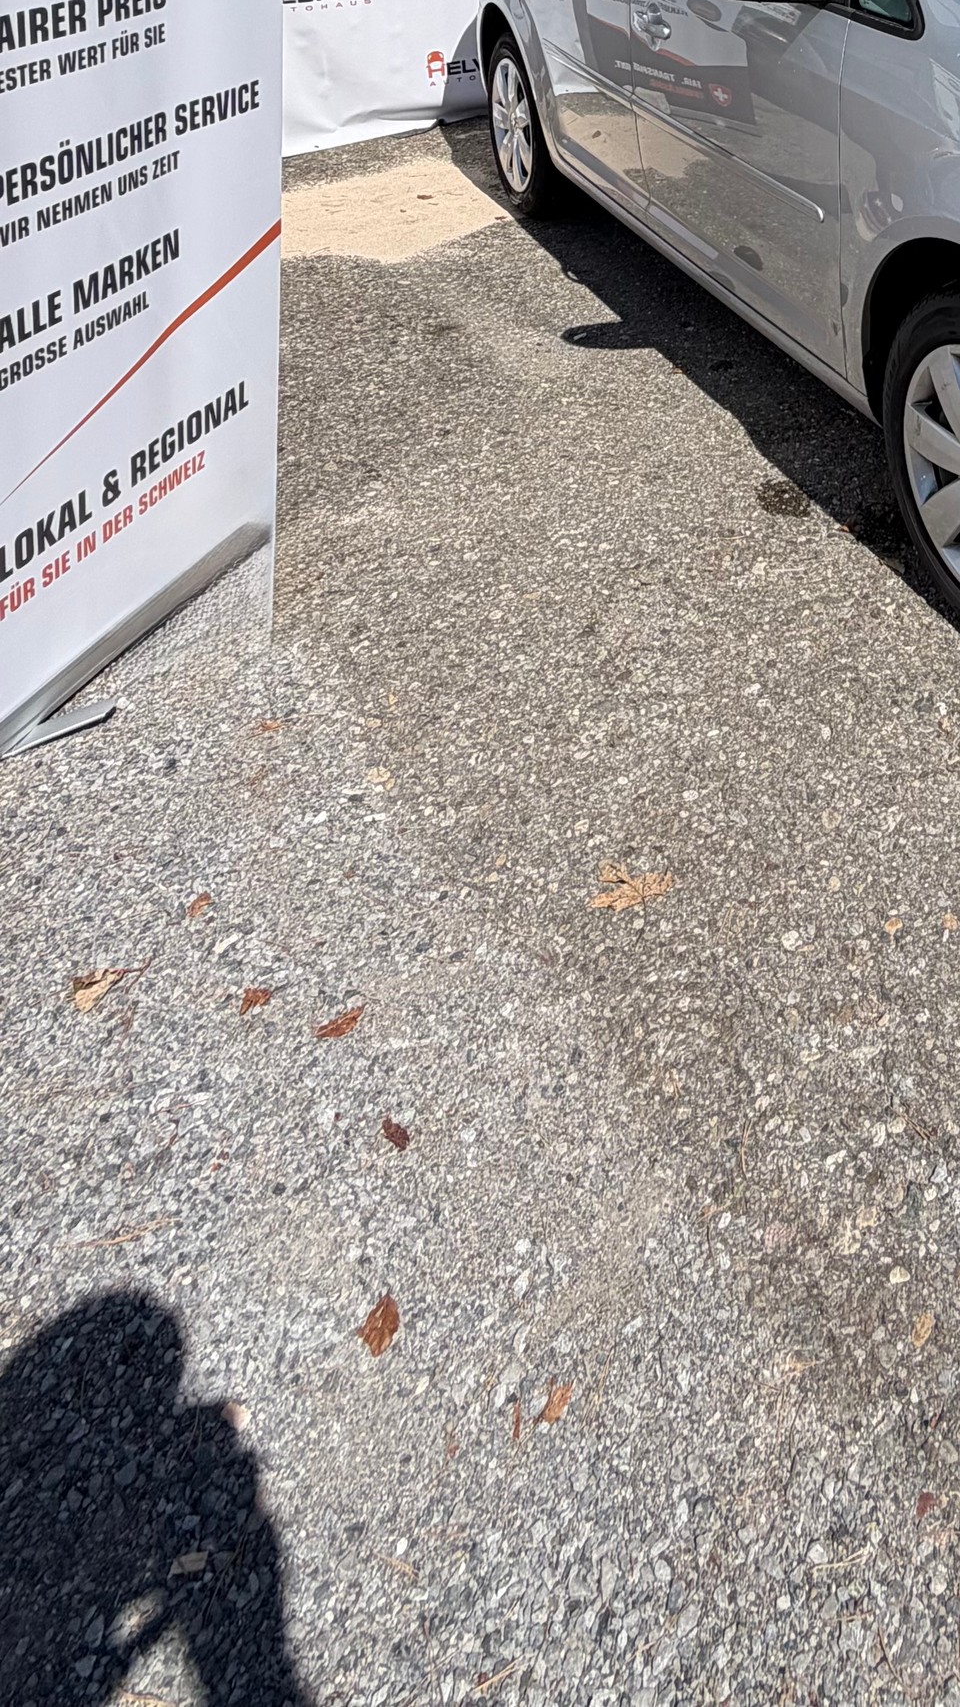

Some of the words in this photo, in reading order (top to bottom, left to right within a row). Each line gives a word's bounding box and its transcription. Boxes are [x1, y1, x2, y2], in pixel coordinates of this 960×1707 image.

[58, 42, 107, 76] WERT
[112, 29, 140, 60] FÜR
[144, 23, 166, 49] SIE
[0, 111, 167, 206] ERSÖNLICHER
[174, 80, 260, 137] SERVICE
[37, 181, 112, 231] NEHMEN
[118, 165, 148, 196] UNS
[152, 150, 180, 180] ZEIT
[0, 290, 63, 354] ALLE
[73, 228, 180, 314] MARKEN
[0, 335, 68, 392] GROSSE
[73, 291, 150, 350] AUSWAHL
[0, 489, 93, 584] LOKAL
[102, 468, 122, 508] &
[130, 380, 249, 488] REGIONAL
[0, 577, 36, 622] FÜR
[42, 550, 71, 588] SIE
[77, 530, 97, 563] IN
[102, 504, 133, 544] DER
[139, 450, 206, 516] SCHWEIZ
